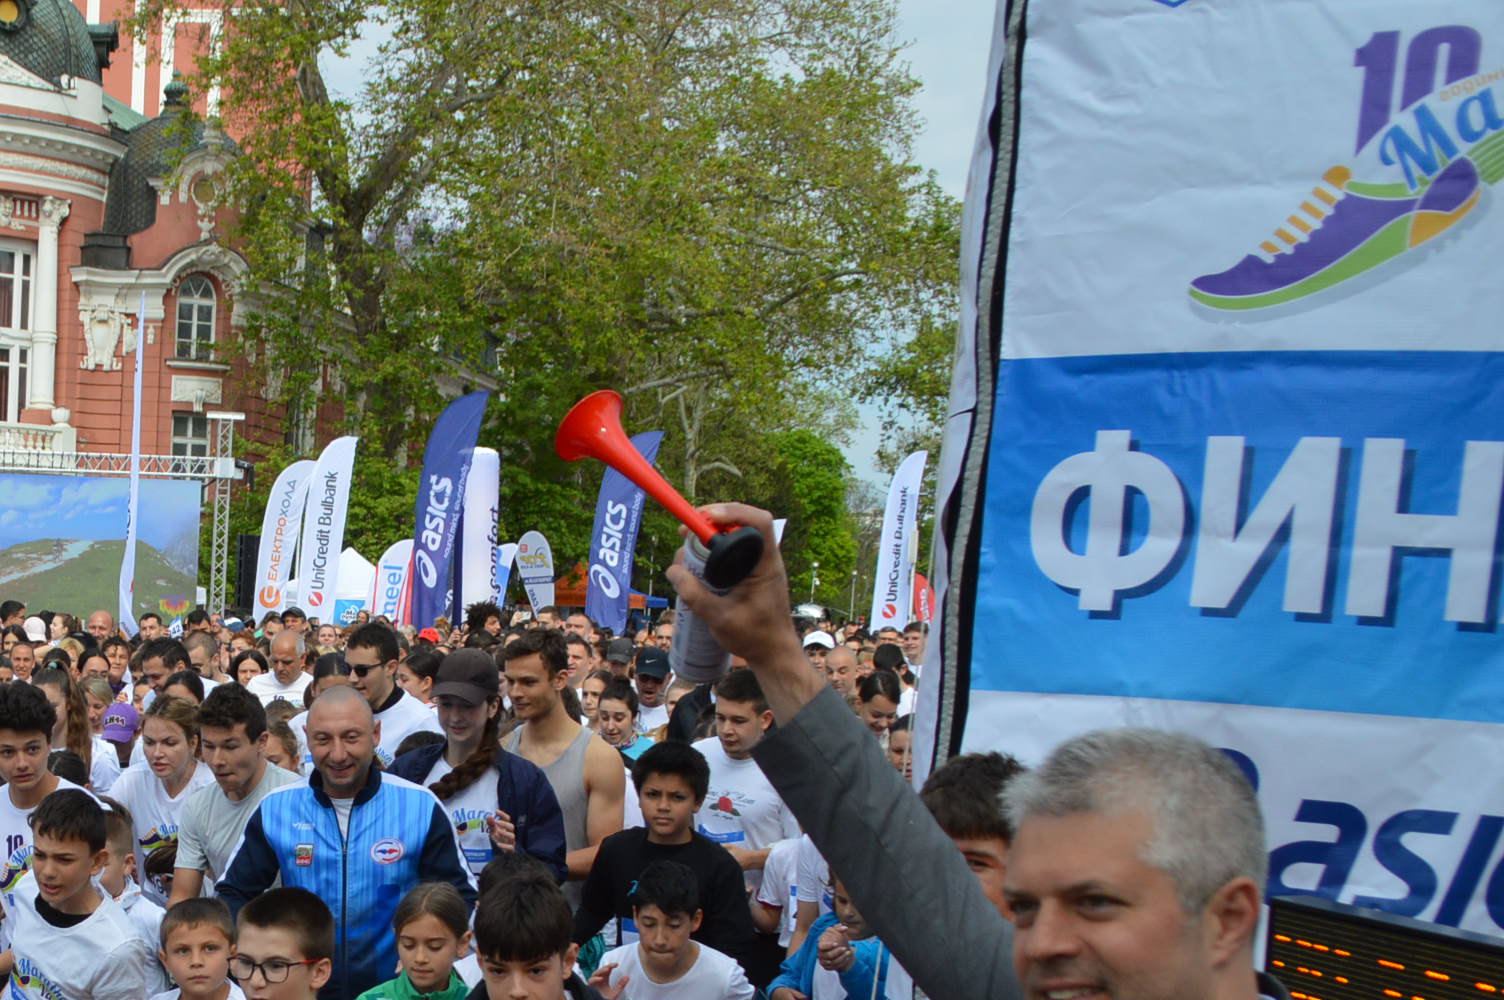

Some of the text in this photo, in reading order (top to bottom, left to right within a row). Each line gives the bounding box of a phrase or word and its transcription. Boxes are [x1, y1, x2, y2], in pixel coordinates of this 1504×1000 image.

[268, 479, 296, 582] ЕЛЕКТРОХОЛД
[311, 471, 339, 590] UniCredit Bulbank
[599, 500, 627, 567] asics
[886, 543, 902, 602] UniCredit
[1031, 430, 1504, 633] ФИН
[1267, 799, 1504, 928] asi
